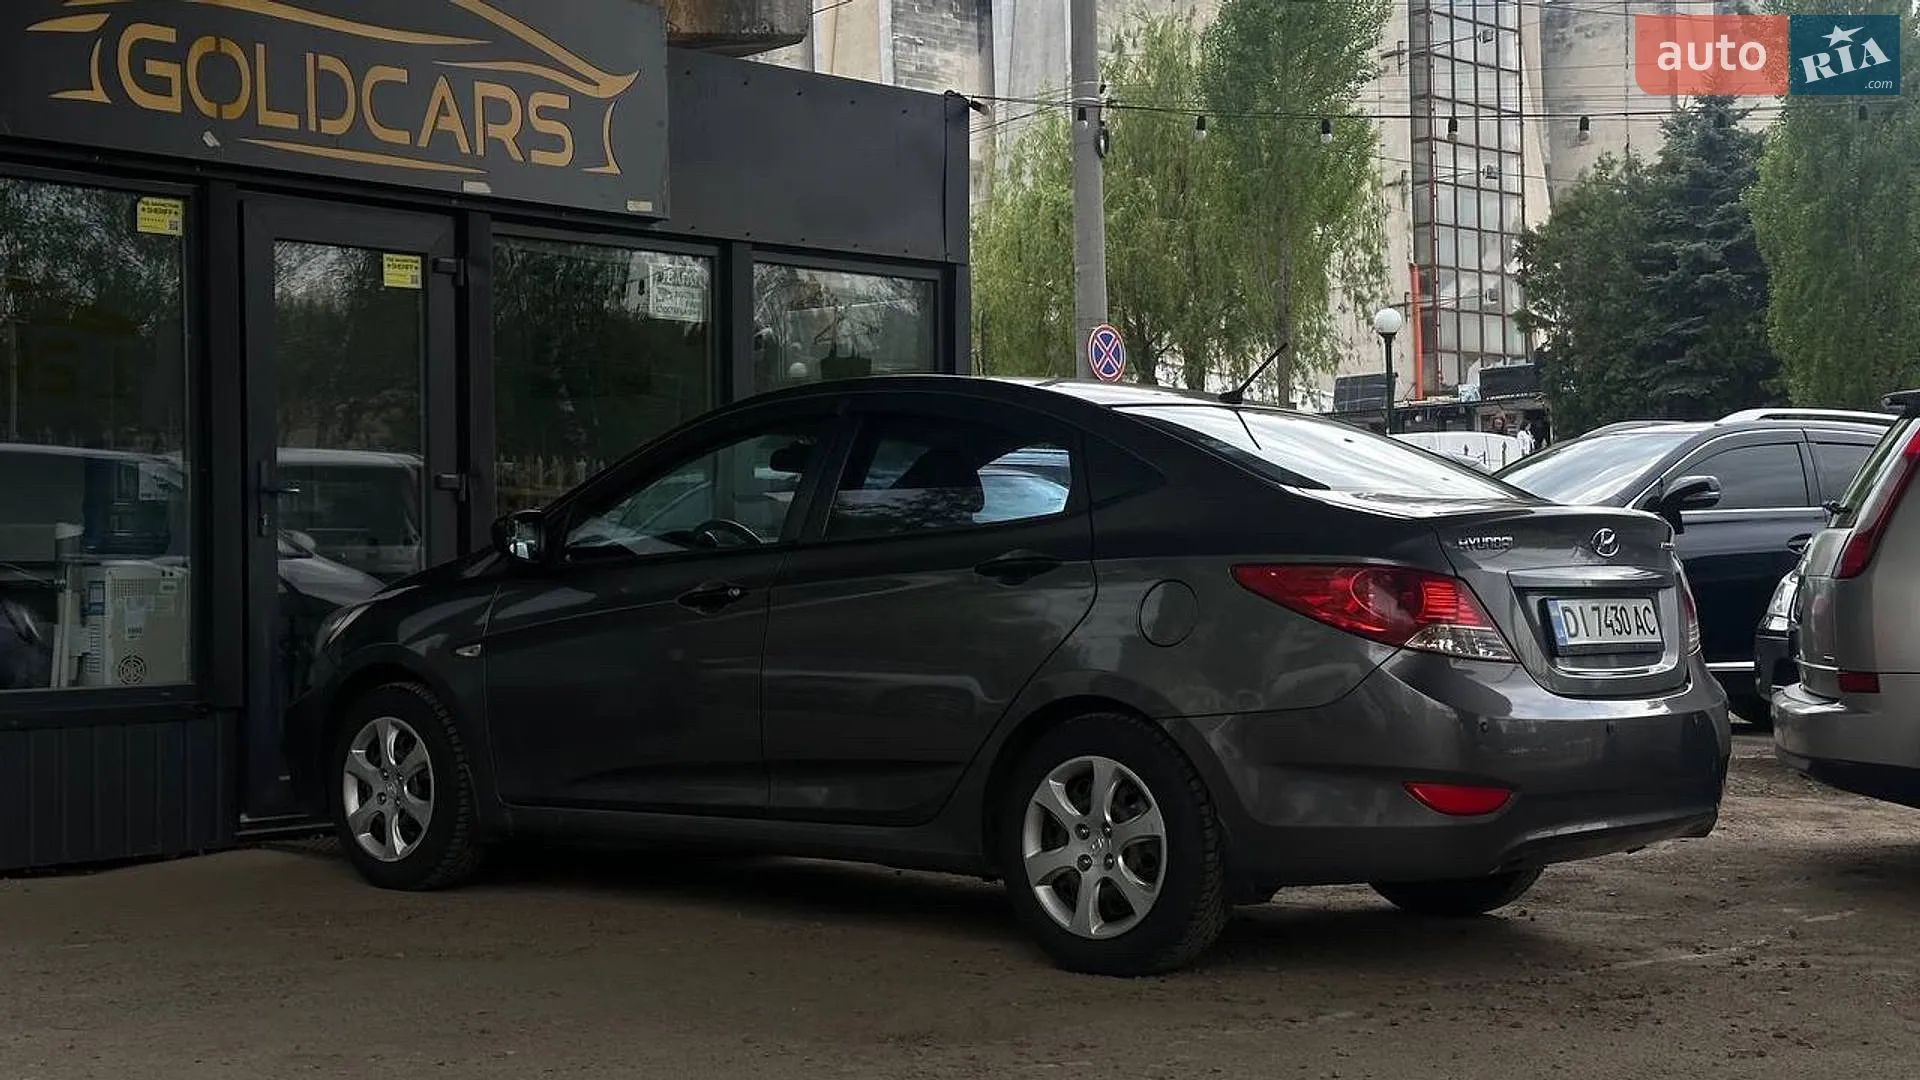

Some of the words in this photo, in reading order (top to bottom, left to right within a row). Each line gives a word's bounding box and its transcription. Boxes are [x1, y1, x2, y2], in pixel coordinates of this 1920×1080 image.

[116, 22, 575, 168] GOLDCARS
[1562, 606, 1590, 638] DI
[1592, 604, 1632, 636] 7430
[1634, 603, 1657, 635] AC
